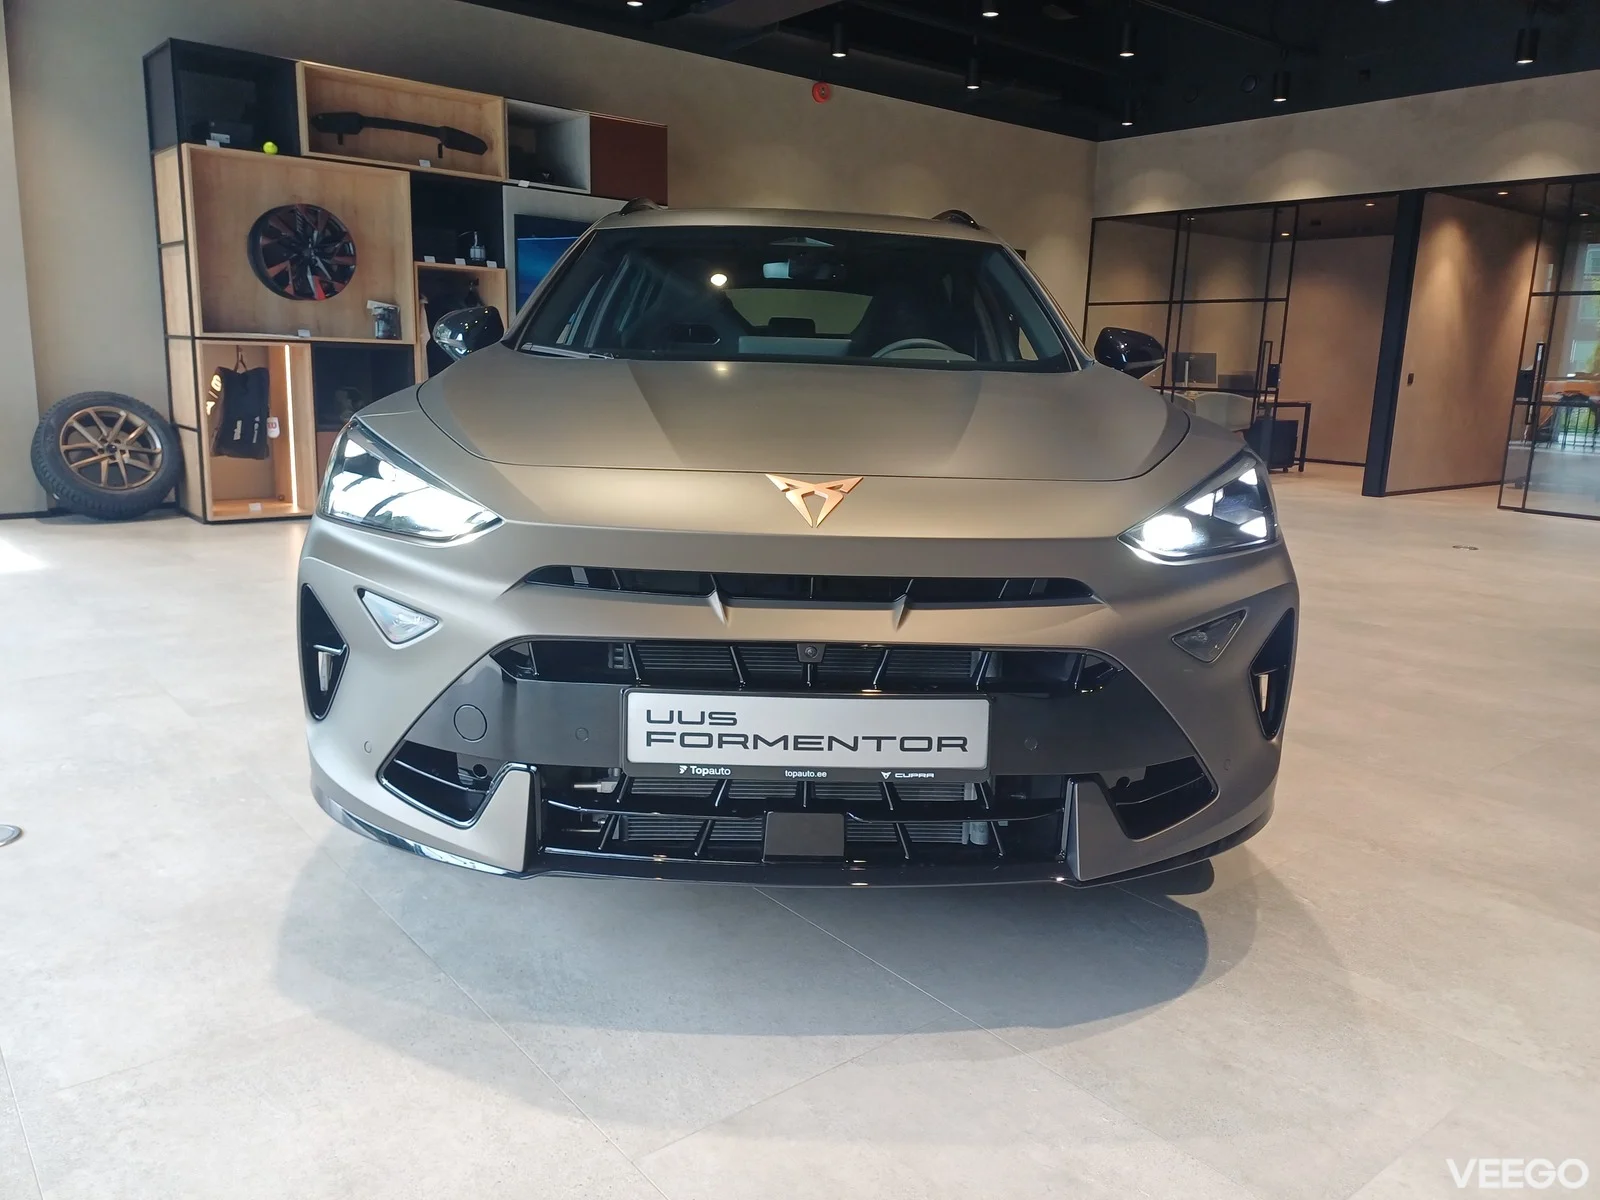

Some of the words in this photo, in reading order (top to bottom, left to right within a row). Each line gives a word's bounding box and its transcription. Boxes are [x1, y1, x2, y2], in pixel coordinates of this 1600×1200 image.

[646, 709, 738, 727] UUS
[646, 731, 968, 753] FORMENTOR
[690, 765, 731, 777] Topauto
[784, 769, 827, 779] topauto.ee
